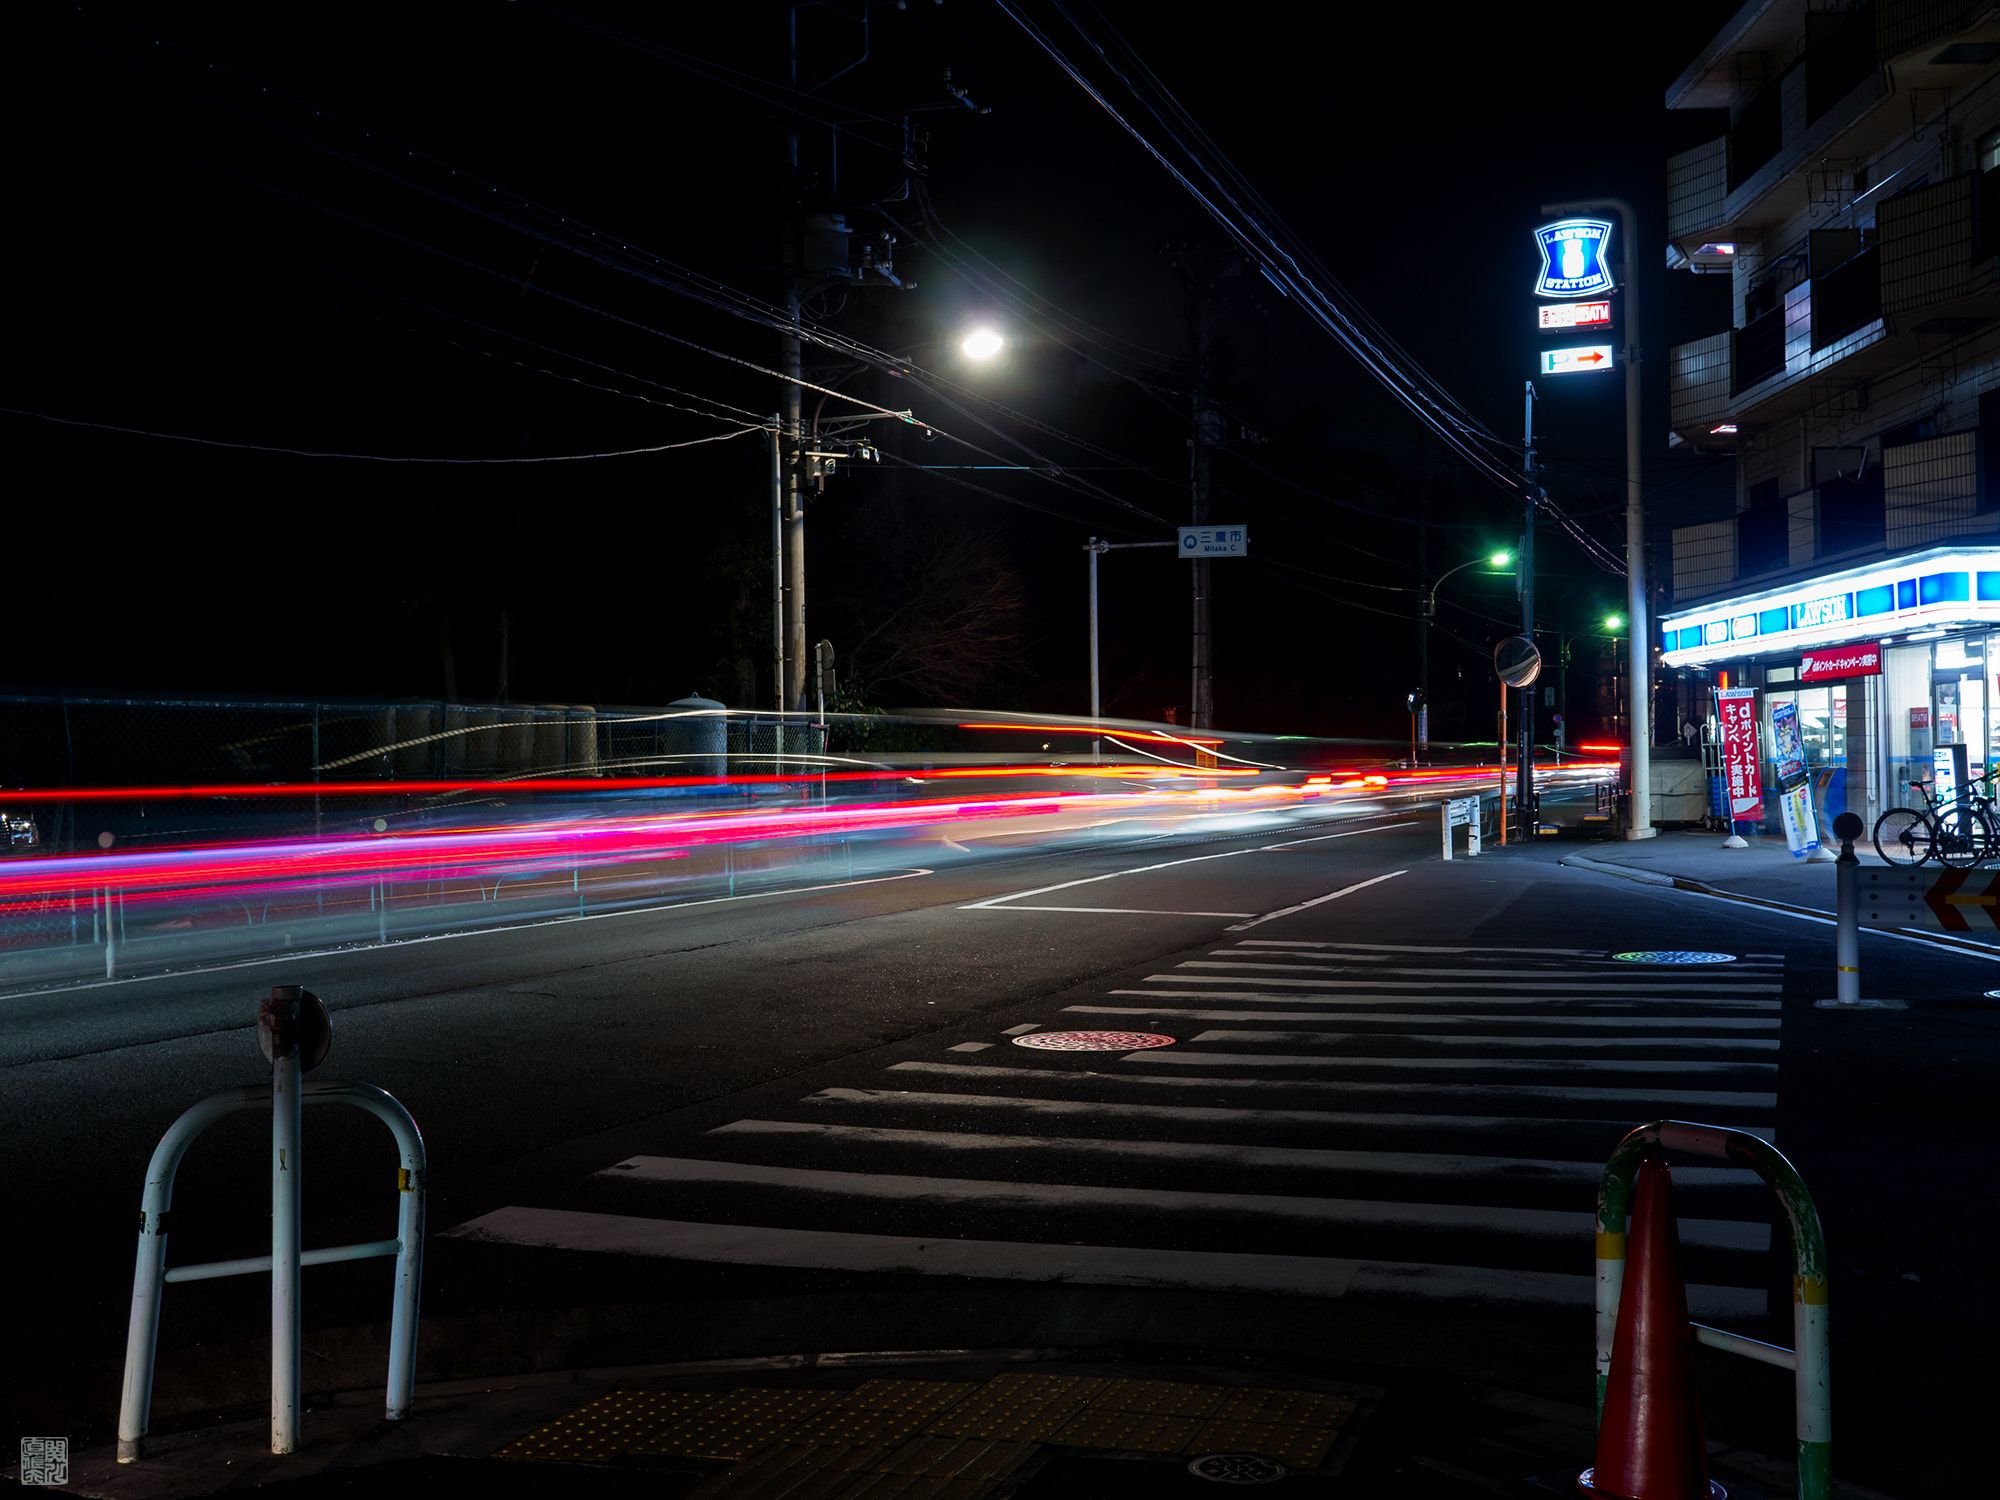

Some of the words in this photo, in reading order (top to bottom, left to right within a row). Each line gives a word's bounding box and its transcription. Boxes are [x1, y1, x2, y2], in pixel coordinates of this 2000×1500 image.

[1544, 228, 1603, 244] LAWSON
[1545, 273, 1603, 289] STATION
[1796, 594, 1847, 628] LAWSON
[1720, 690, 1752, 698] LAWSON
[1738, 702, 1757, 797] dポイントカード
